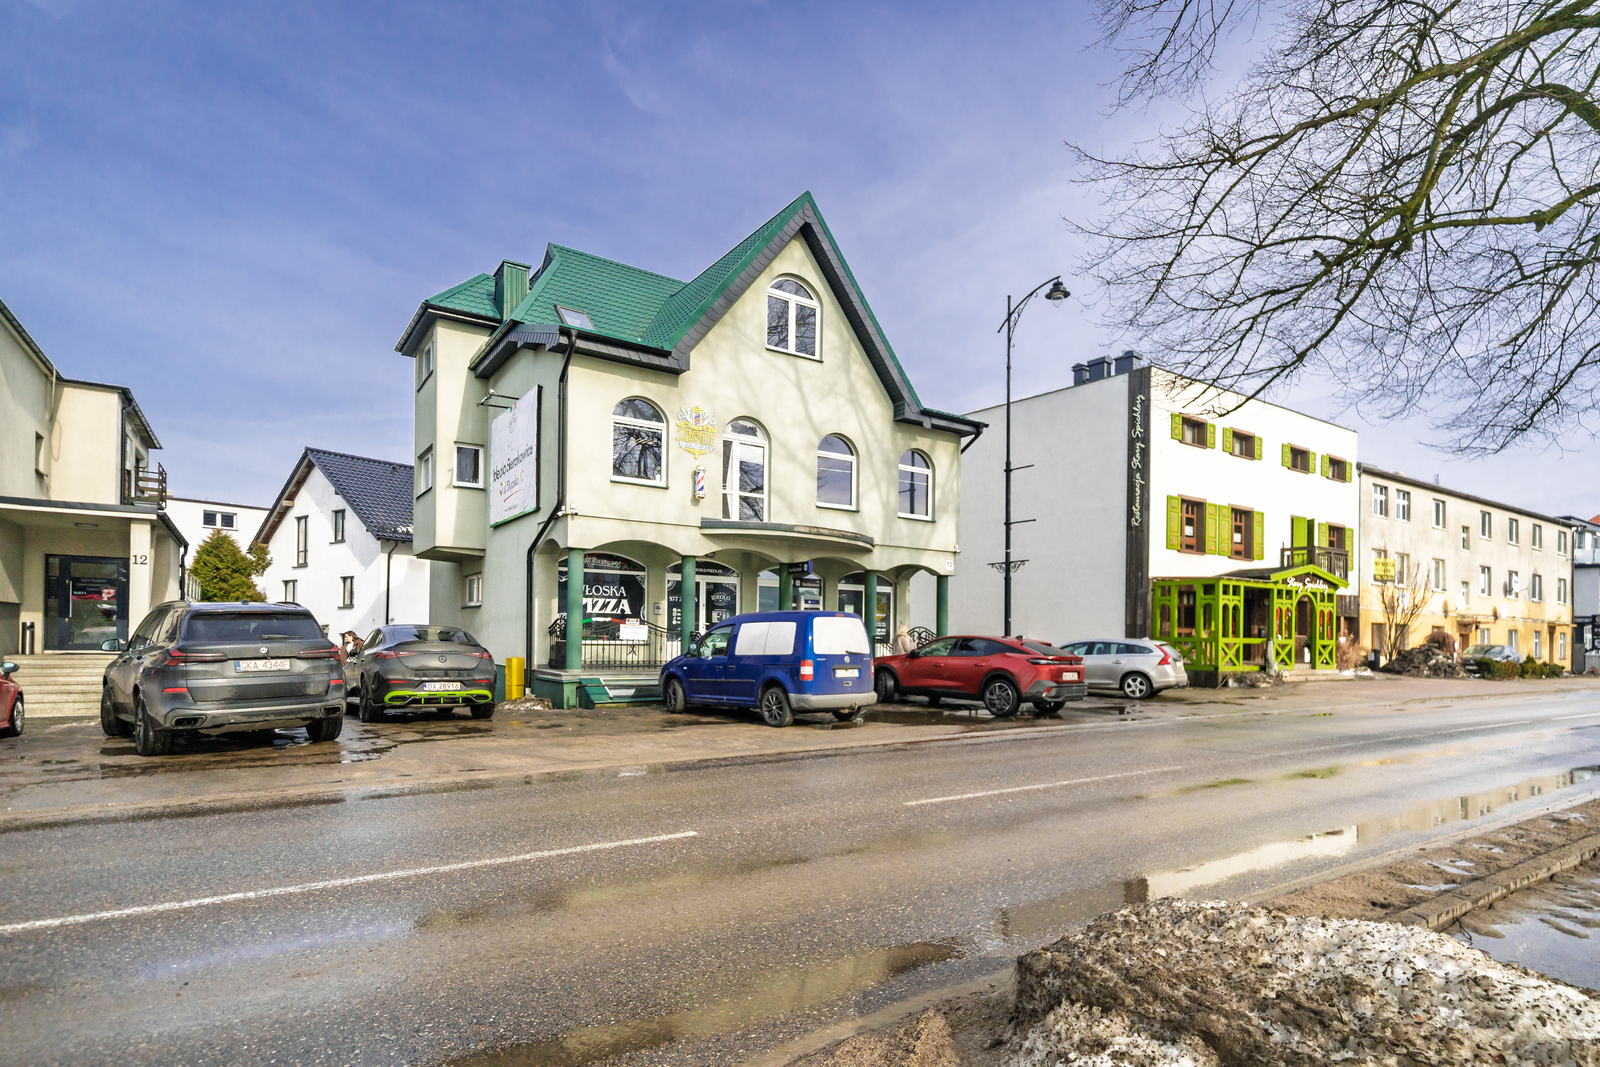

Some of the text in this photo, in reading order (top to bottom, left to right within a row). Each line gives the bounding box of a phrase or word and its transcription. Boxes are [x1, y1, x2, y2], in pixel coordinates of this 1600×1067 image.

[1131, 394, 1145, 527] Restauracja Stary Spichlerz
[132, 554, 148, 565] 12
[1287, 576, 1303, 594] Stary
[241, 661, 259, 670] GKA
